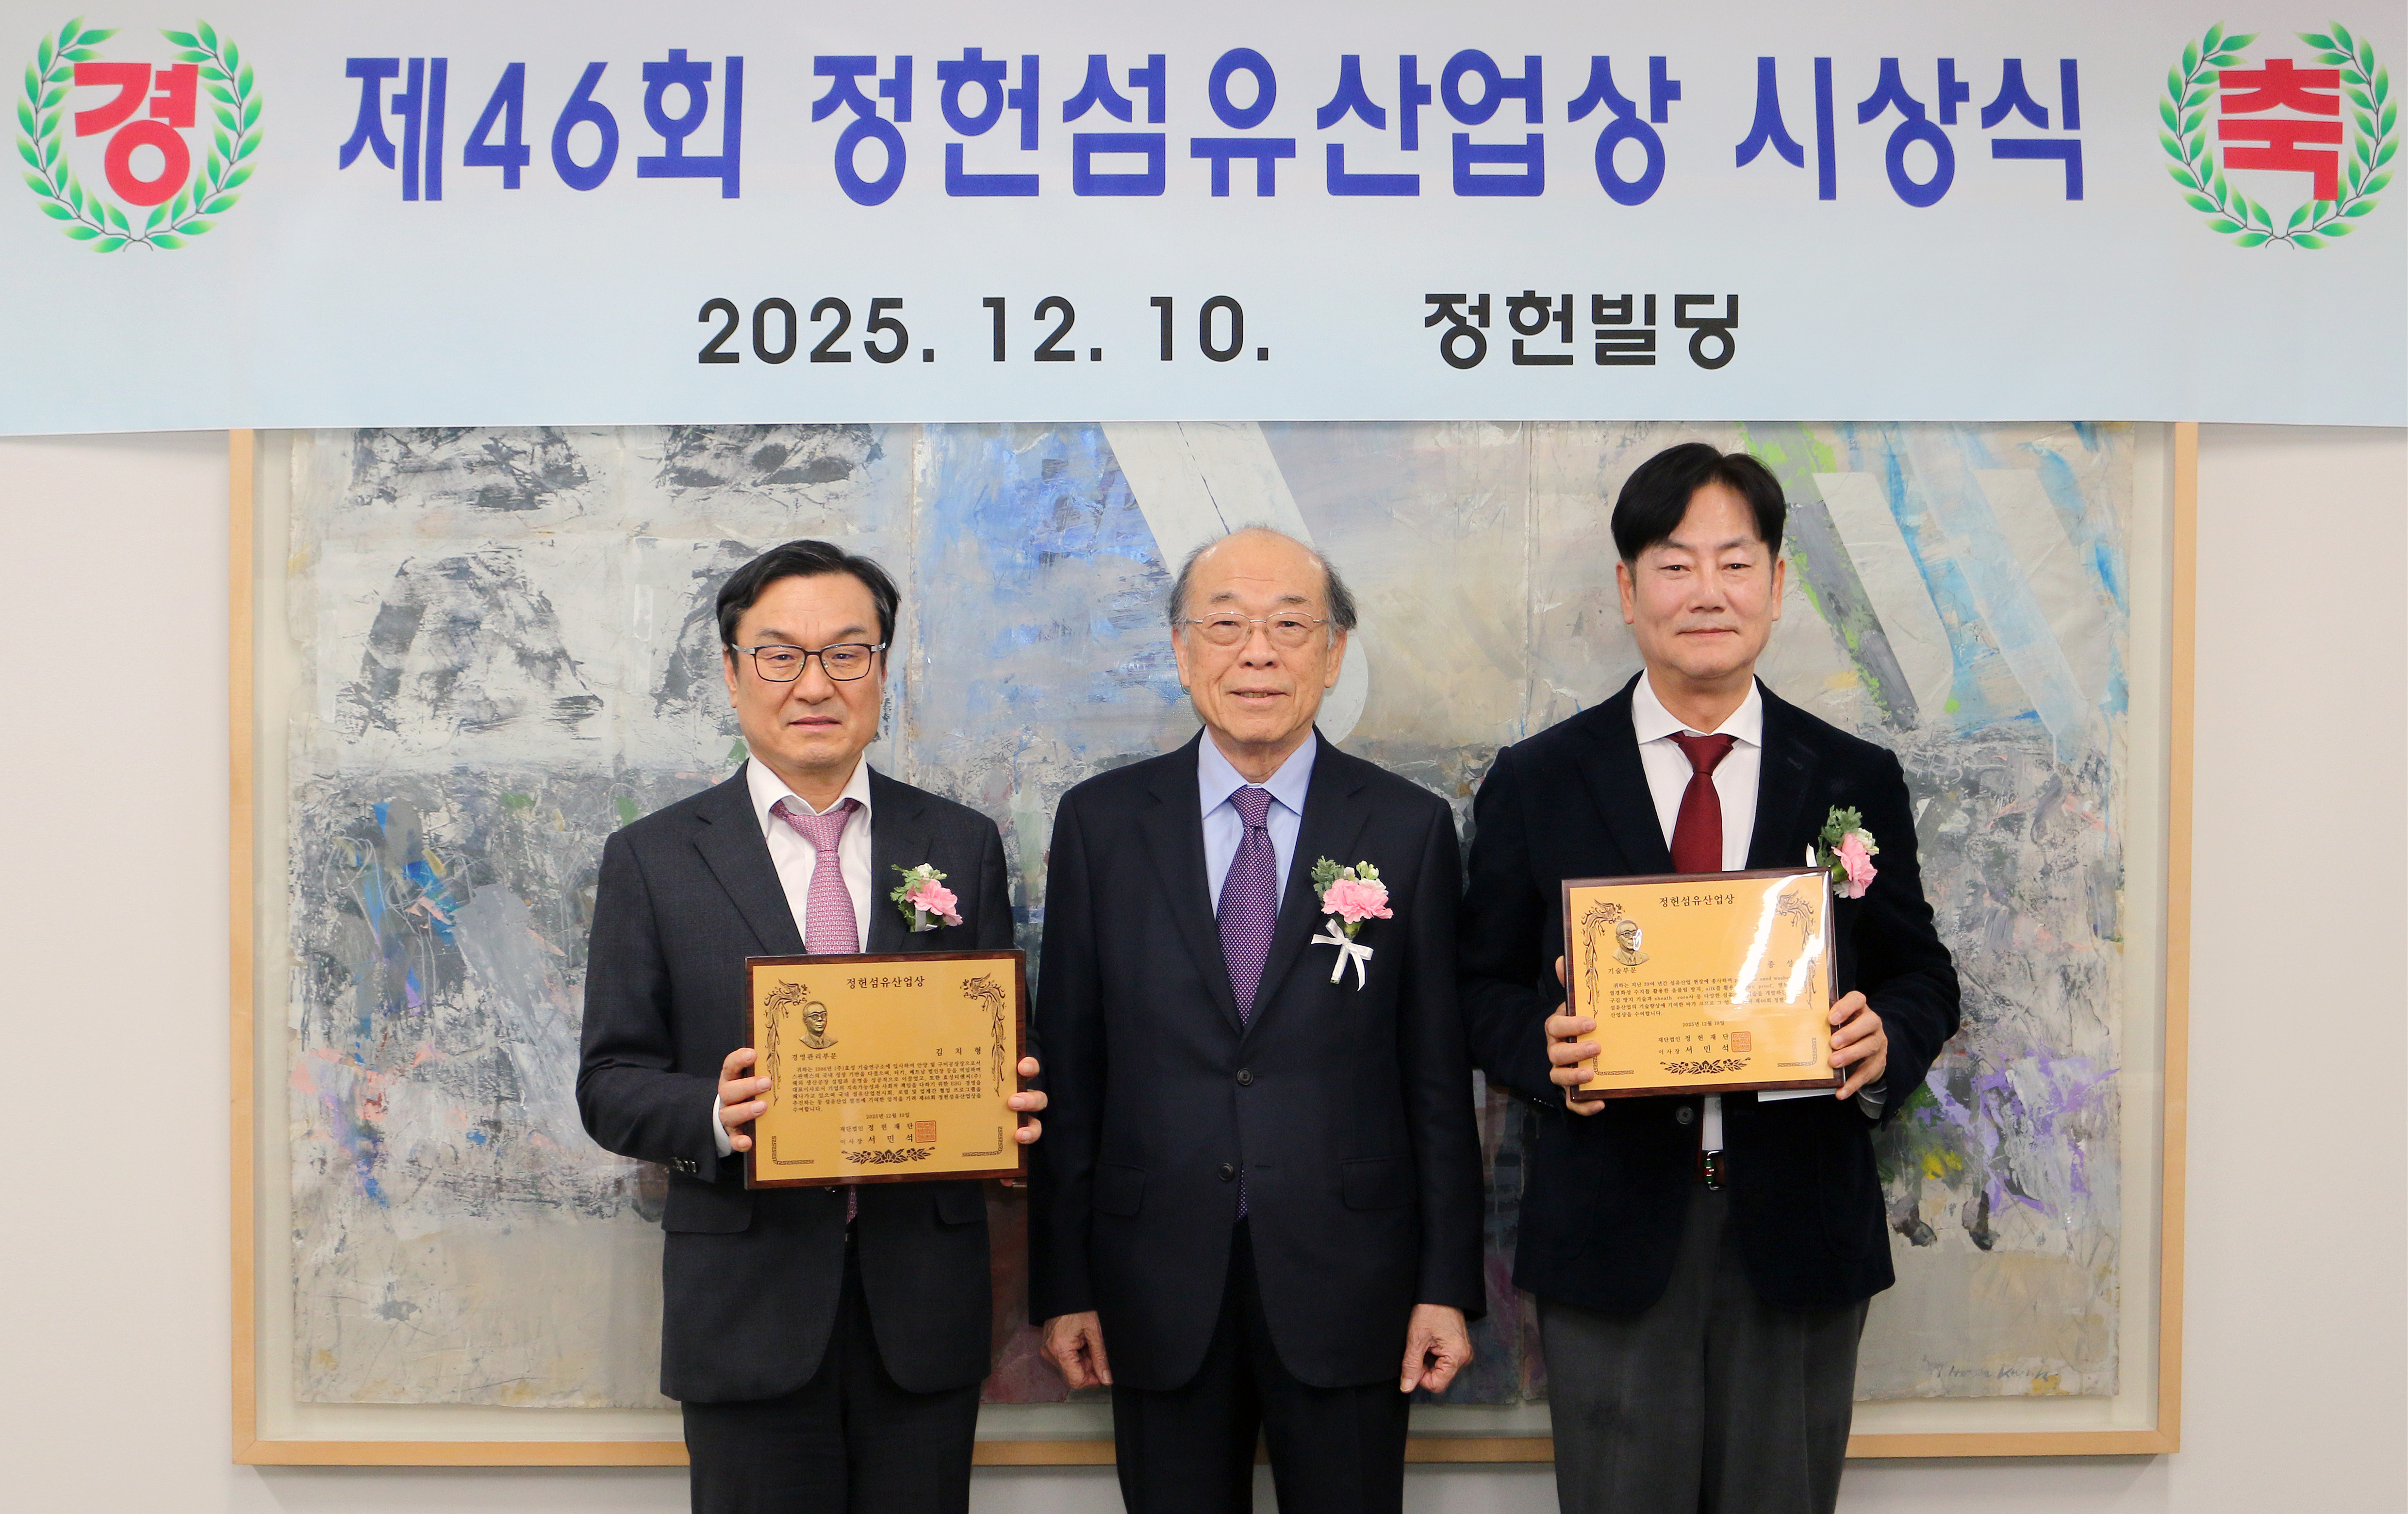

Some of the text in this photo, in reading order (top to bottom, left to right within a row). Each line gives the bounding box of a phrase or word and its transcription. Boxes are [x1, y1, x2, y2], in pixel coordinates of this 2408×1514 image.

[75, 63, 198, 206] 경
[340, 48, 2082, 207] 제46회 정헌섬유산업상 시상식
[2219, 59, 2342, 200] 축
[699, 291, 1738, 369] 2025. 12. 10. 정헌빌딩
[1660, 894, 1734, 907] 정헌섬유산업상
[847, 976, 925, 989] 정헌섬유산업상
